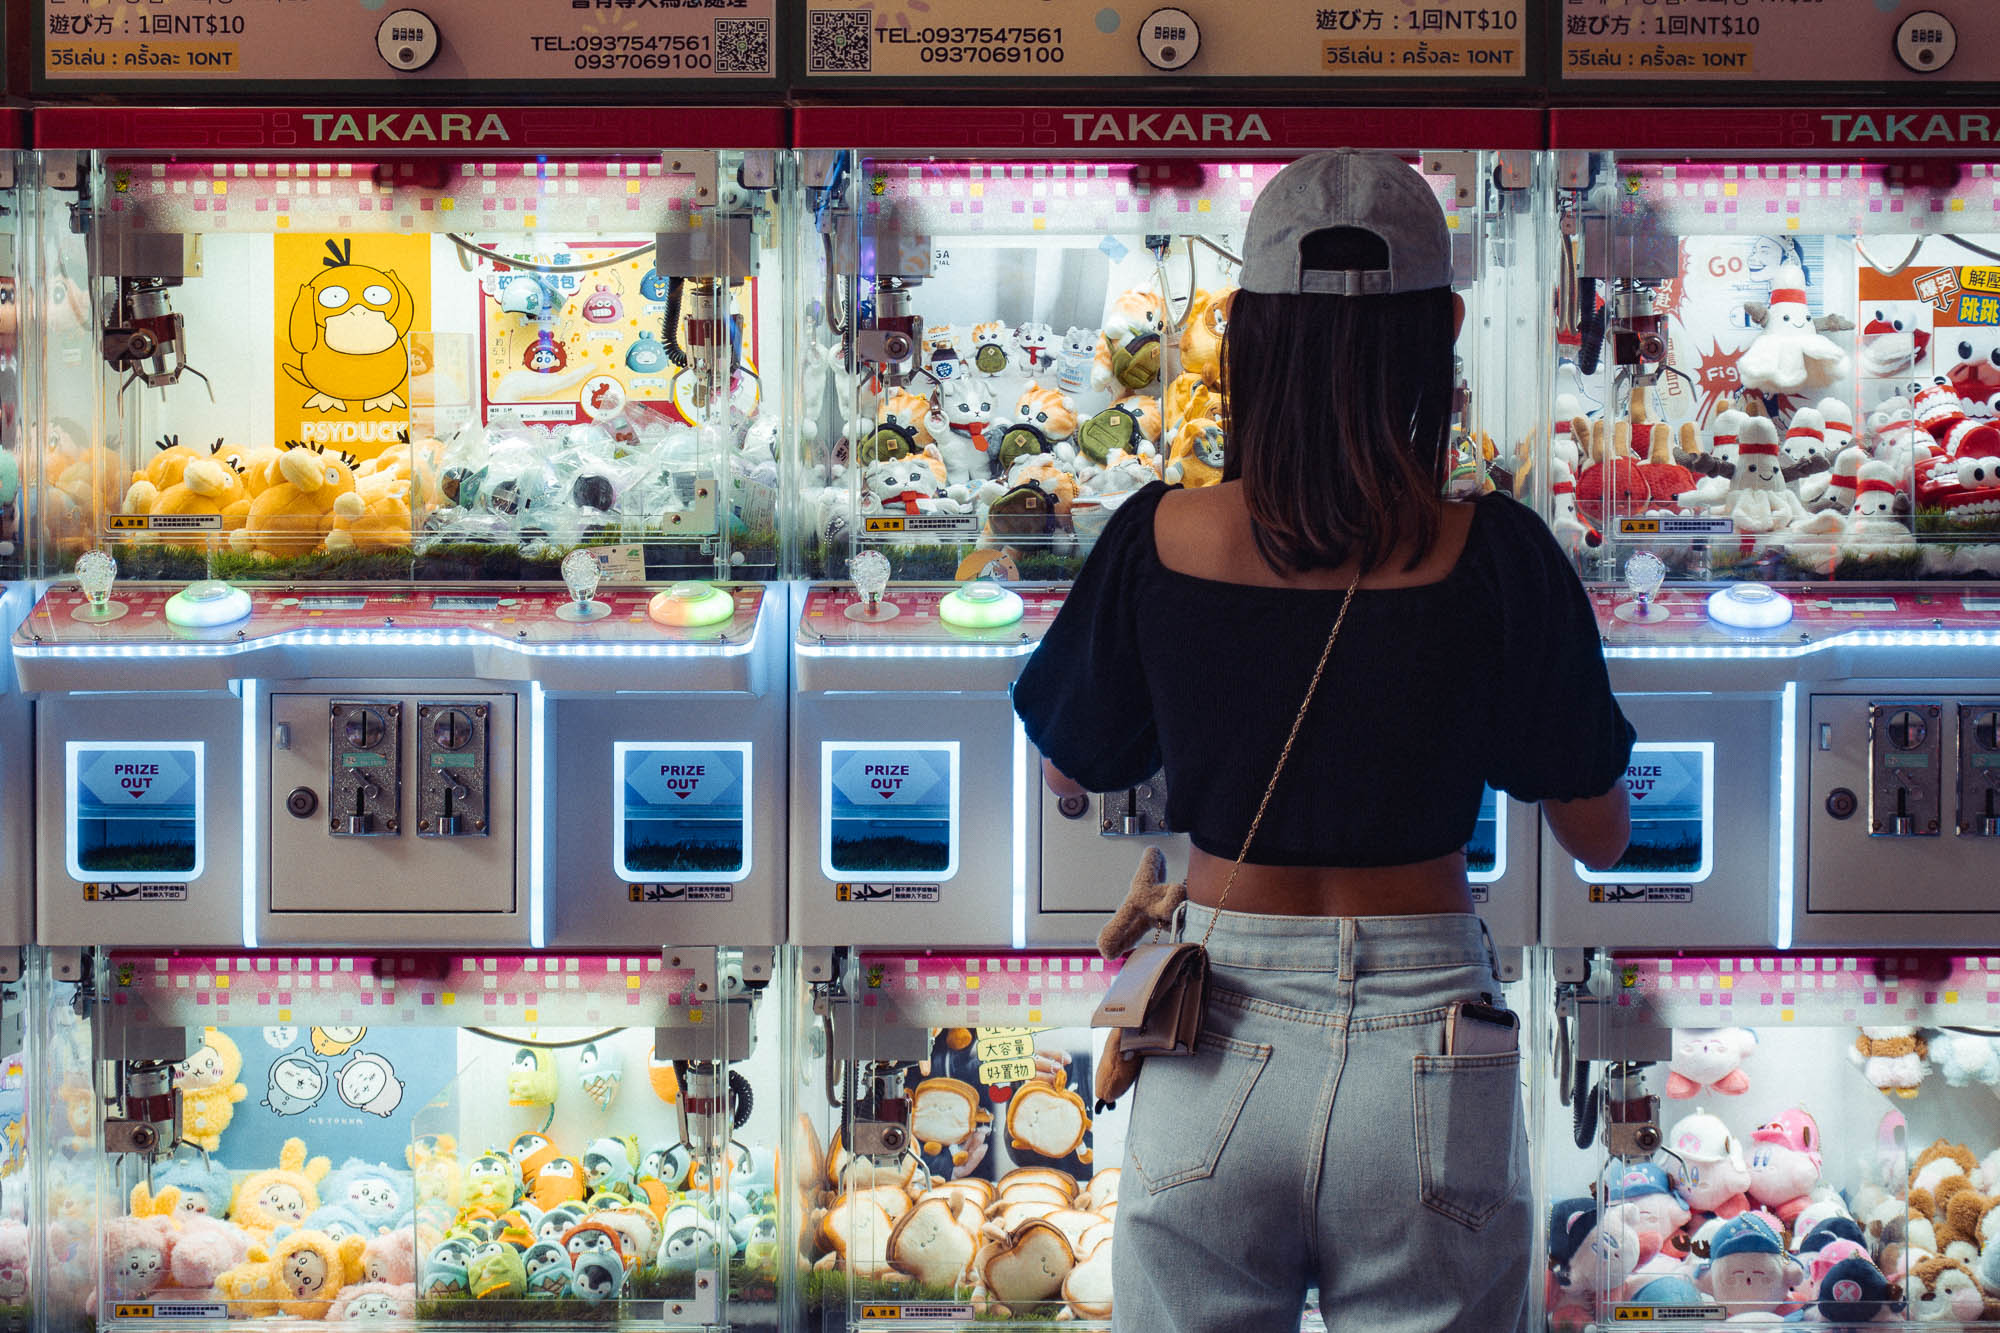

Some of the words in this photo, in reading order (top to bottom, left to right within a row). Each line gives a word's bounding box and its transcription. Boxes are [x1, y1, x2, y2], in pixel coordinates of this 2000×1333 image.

[874, 27, 1063, 44] TEL:0937547561
[530, 36, 711, 51] TEL:0937547561
[187, 51, 233, 66] 10NT
[574, 54, 713, 70] 0937069100
[920, 46, 1065, 63] 0937069100
[1467, 50, 1515, 64] 10NT
[1702, 52, 1747, 67] 10NT
[302, 113, 511, 142] TAKARA
[1063, 113, 1273, 142] TAKARA
[1820, 114, 2000, 142] TAKAR
[300, 420, 409, 442] PSYDUCK
[114, 764, 160, 775] PRIZE
[660, 765, 706, 776] PRIZE
[864, 765, 910, 776] PRIZE
[1627, 766, 1662, 777] RIZE
[120, 777, 153, 789] OUT
[666, 778, 700, 790] OUT
[871, 778, 904, 789] OUT
[985, 1039, 1025, 1057] 大容量
